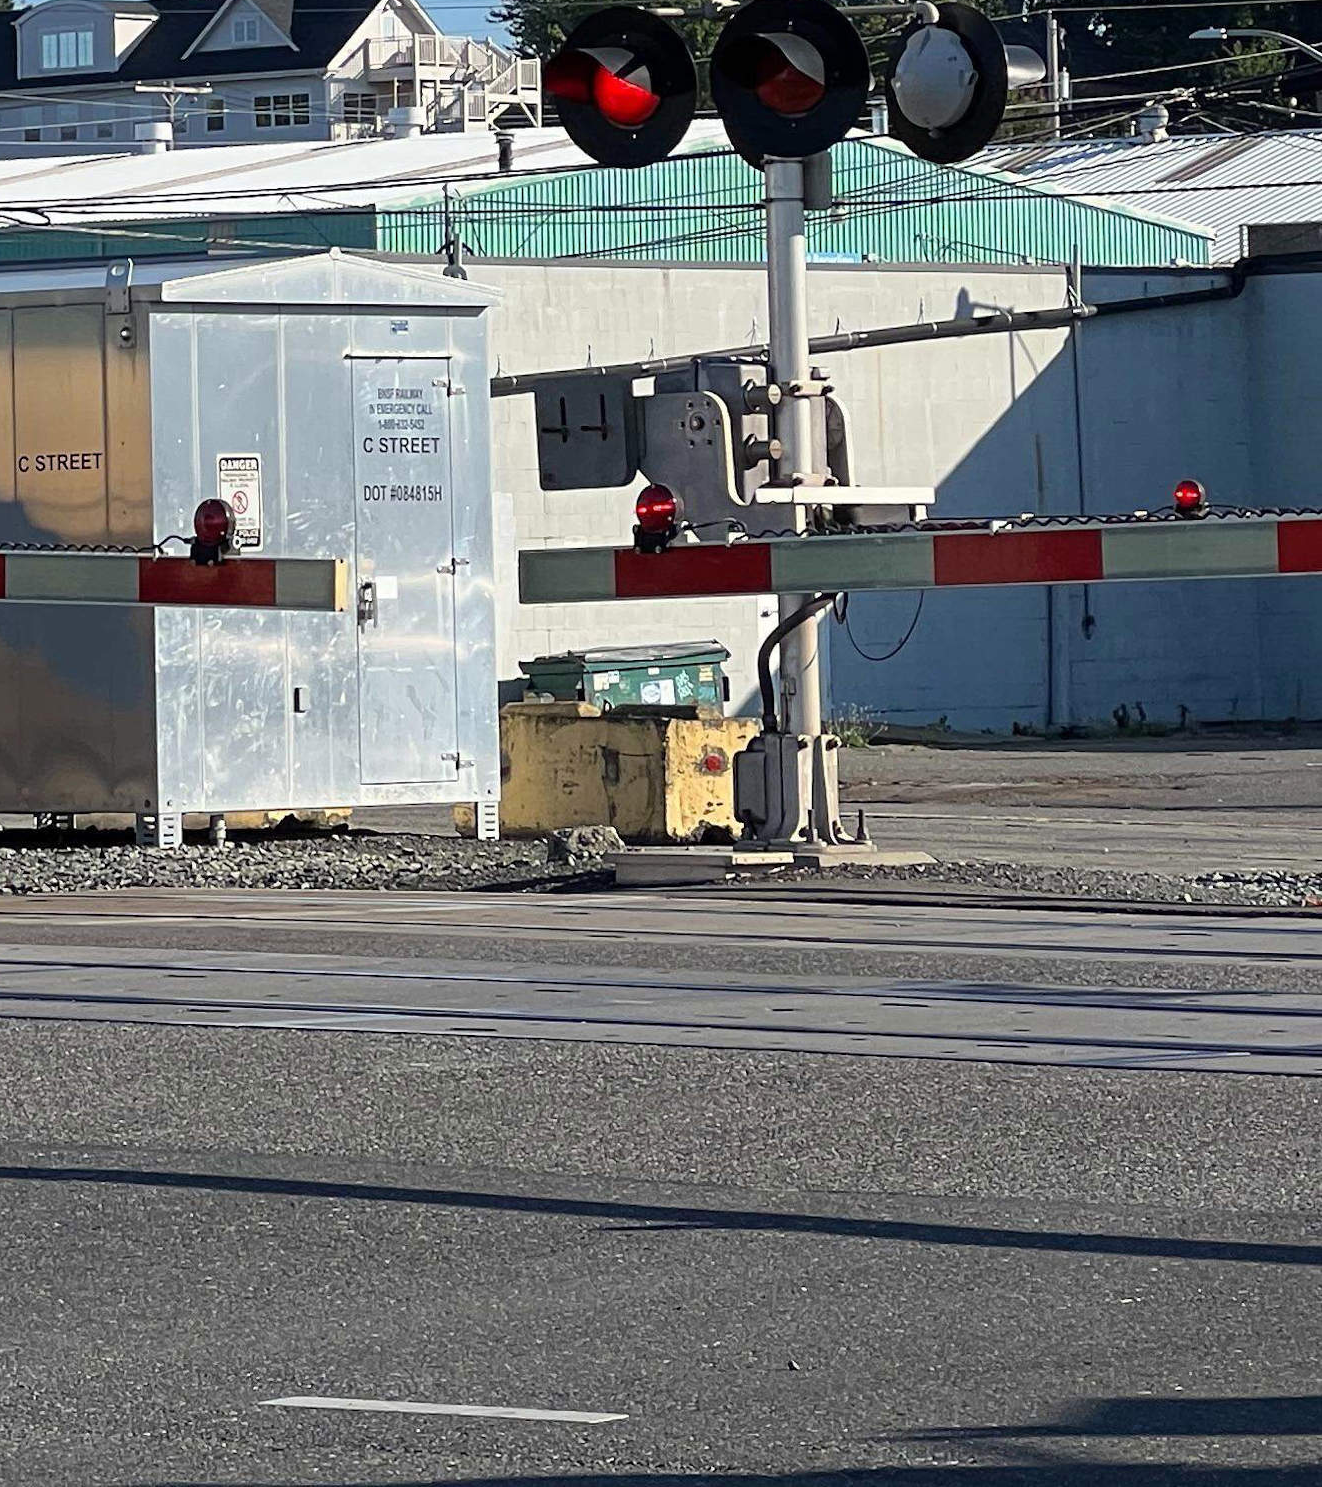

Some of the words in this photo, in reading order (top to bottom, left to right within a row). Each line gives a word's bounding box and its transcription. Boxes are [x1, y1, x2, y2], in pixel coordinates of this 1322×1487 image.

[363, 437, 373, 453] C
[379, 437, 440, 453] STREET
[18, 456, 29, 473] C
[35, 453, 103, 472] STREET
[220, 459, 258, 470] DANGER
[363, 485, 388, 501] DOT
